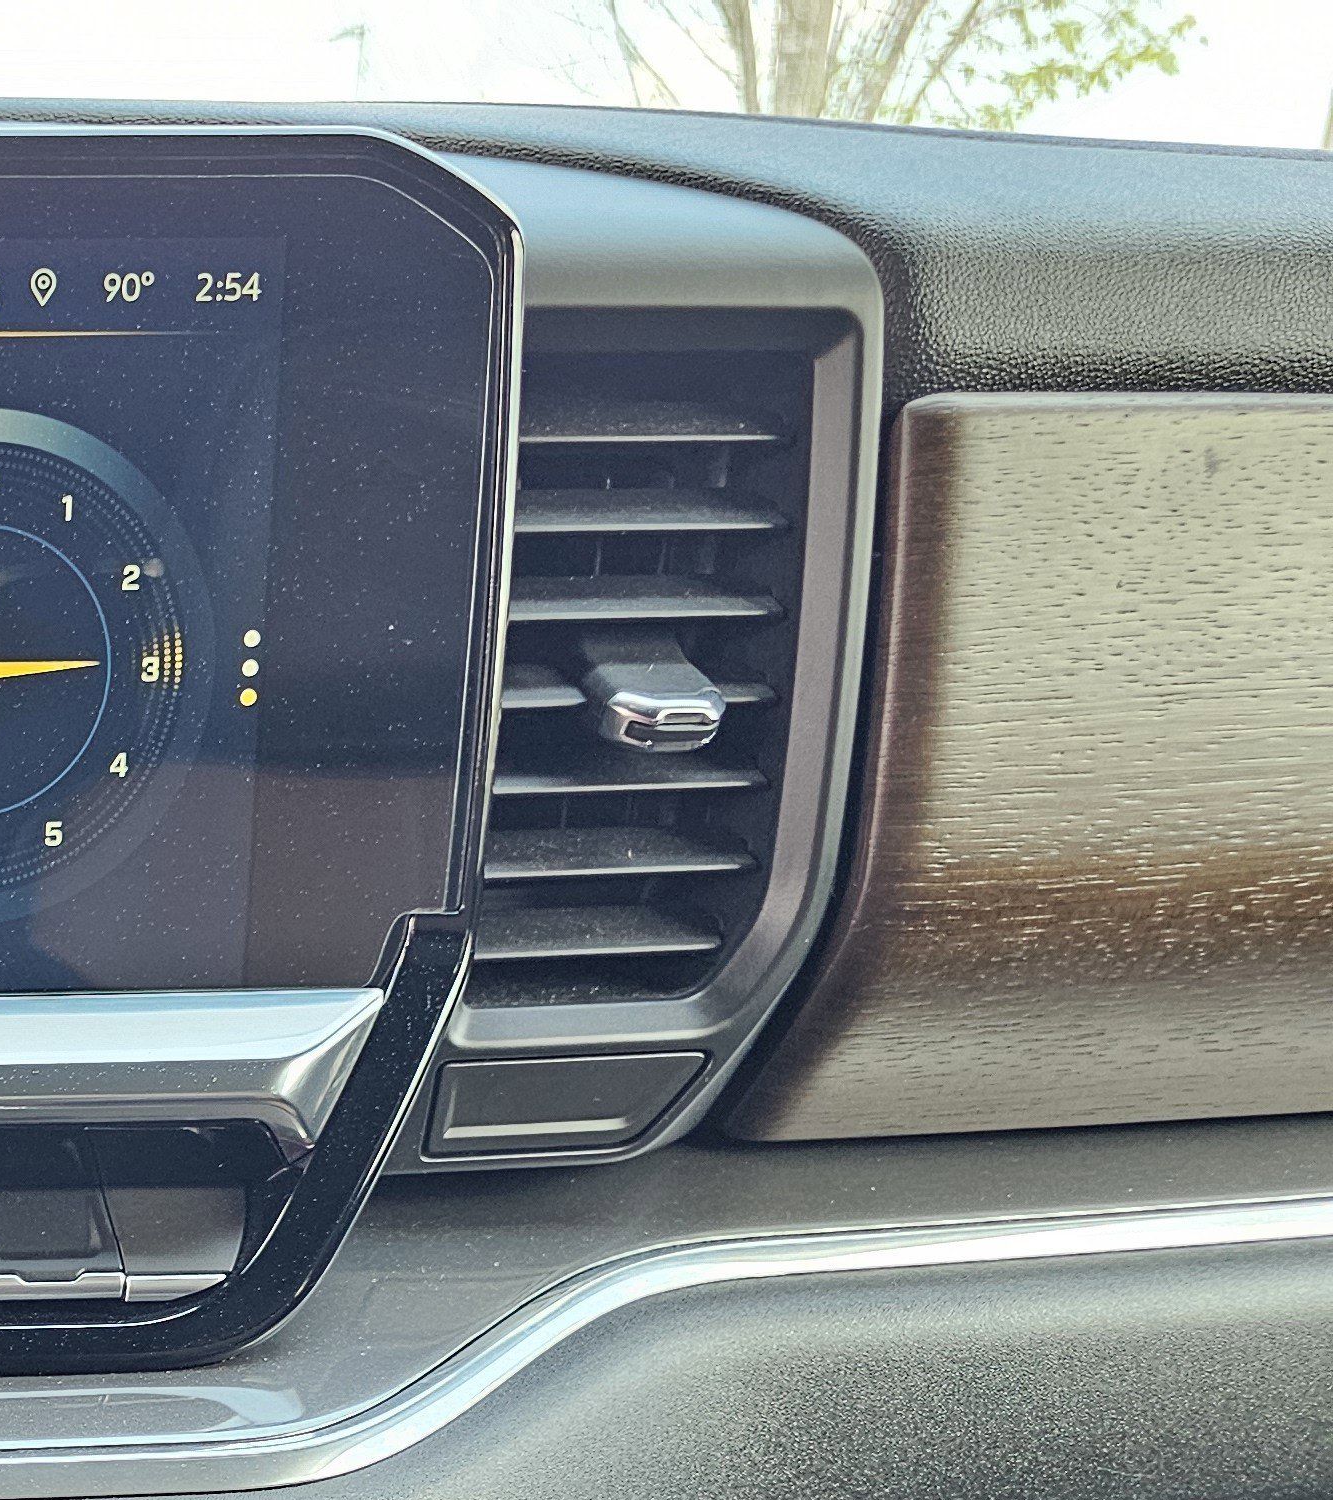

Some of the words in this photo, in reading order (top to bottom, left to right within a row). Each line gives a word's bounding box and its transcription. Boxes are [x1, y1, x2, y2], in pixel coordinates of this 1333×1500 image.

[103, 272, 155, 302] 90°
[195, 272, 262, 302] 2:54
[60, 495, 74, 521] 1
[121, 565, 141, 592] 2
[140, 656, 160, 682] 3
[109, 752, 129, 778] 4
[43, 821, 64, 848] 5
